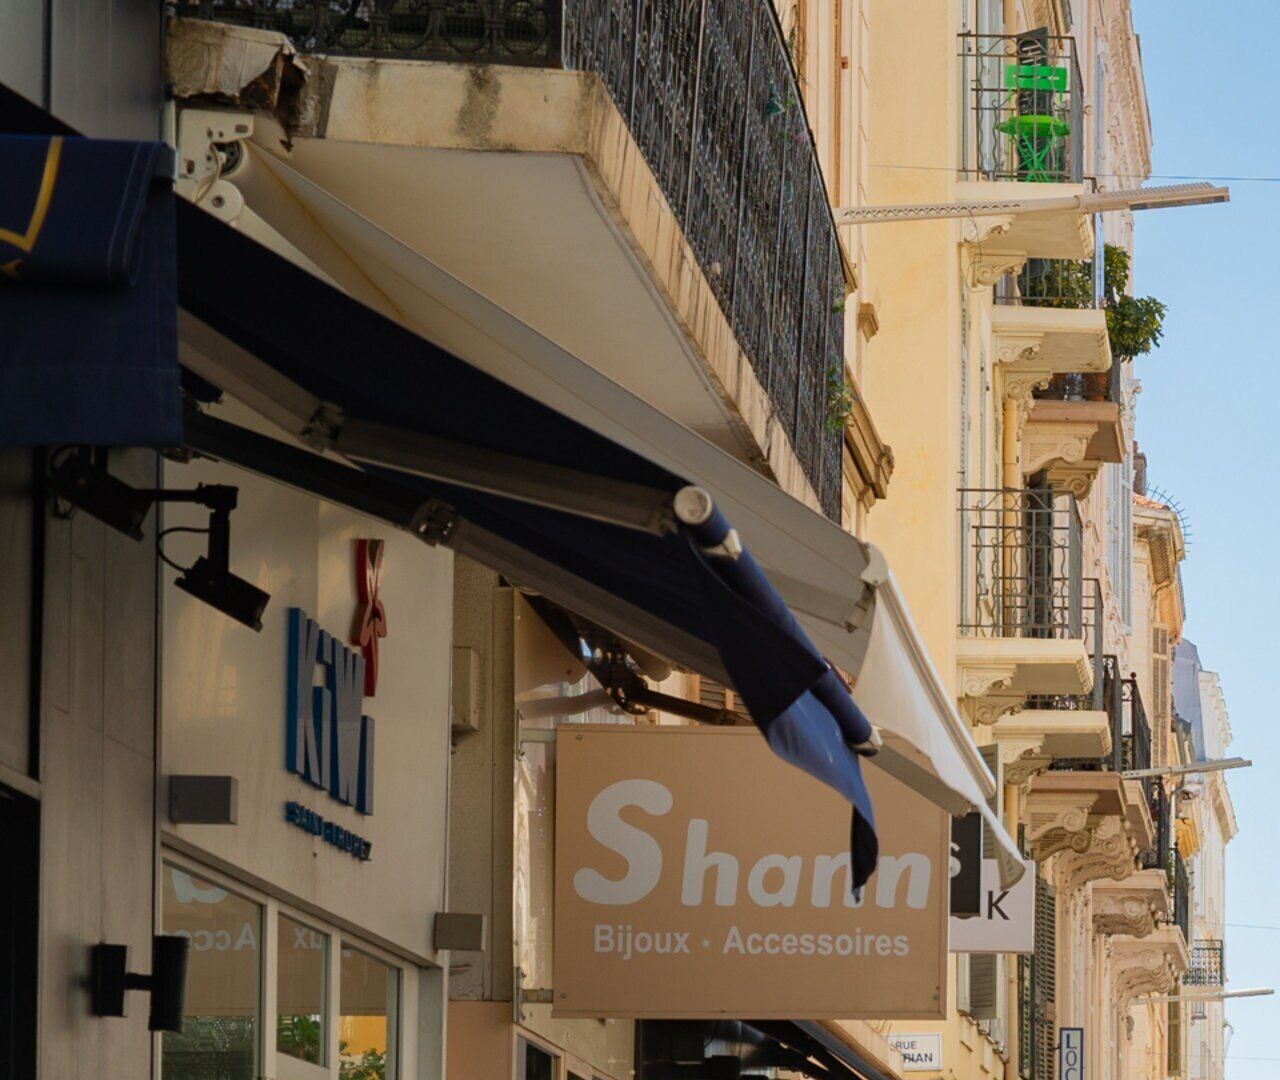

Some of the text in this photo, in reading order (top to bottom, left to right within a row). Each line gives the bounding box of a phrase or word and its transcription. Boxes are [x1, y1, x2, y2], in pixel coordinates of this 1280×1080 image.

[572, 779, 932, 910] Shann
[593, 925, 910, 961] Bijoux Accessoires
